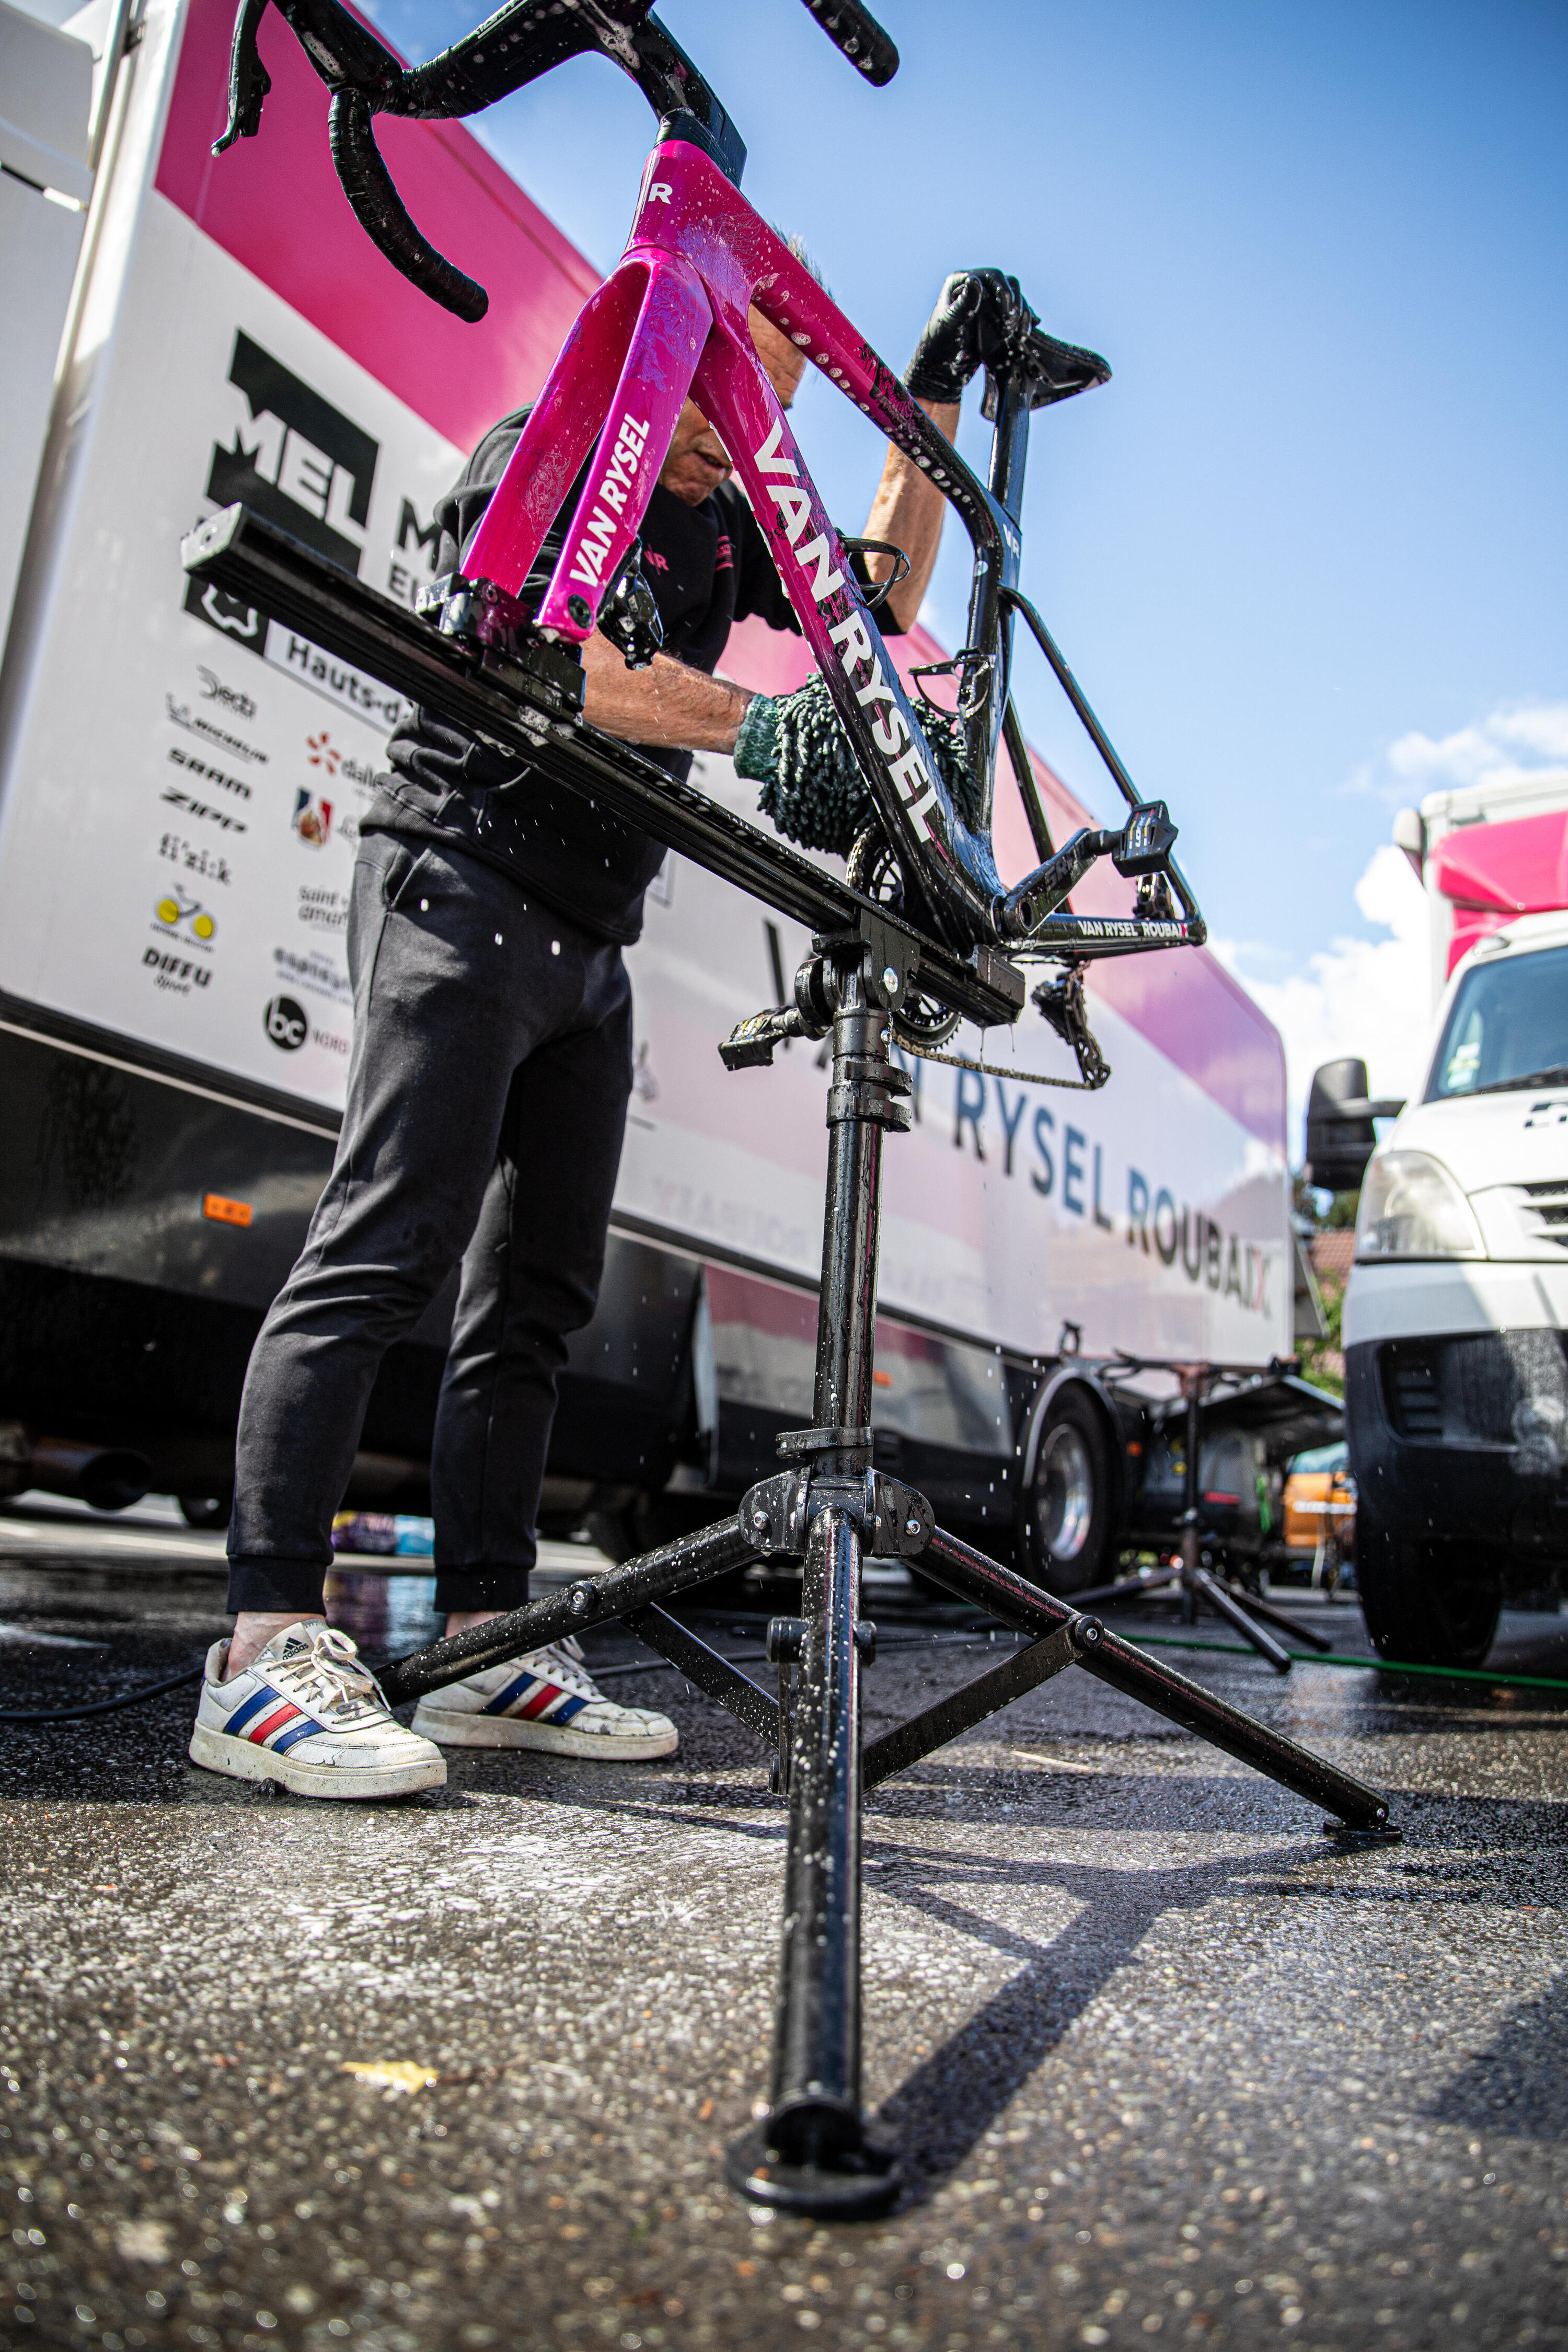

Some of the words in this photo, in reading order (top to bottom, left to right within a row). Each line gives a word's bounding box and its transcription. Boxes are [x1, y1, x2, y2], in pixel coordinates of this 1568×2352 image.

[212, 377, 367, 550] MEL
[569, 506, 617, 587] VAN
[598, 413, 650, 515] RYSEL
[753, 416, 845, 603] VAN
[828, 609, 945, 843] RYSEL
[193, 717, 269, 764] MICHELIN
[166, 747, 251, 800] SRAM
[159, 785, 247, 833] ZIPP
[1077, 920, 1103, 936] VAN
[1105, 921, 1138, 937] RYSEL
[1143, 921, 1189, 938] ROUBAIX
[141, 945, 212, 989] DIFFU
[954, 1053, 1112, 1232] RYSEL
[1127, 1167, 1271, 1321] ROUBAIX
[283, 1643, 309, 1661] adidas
